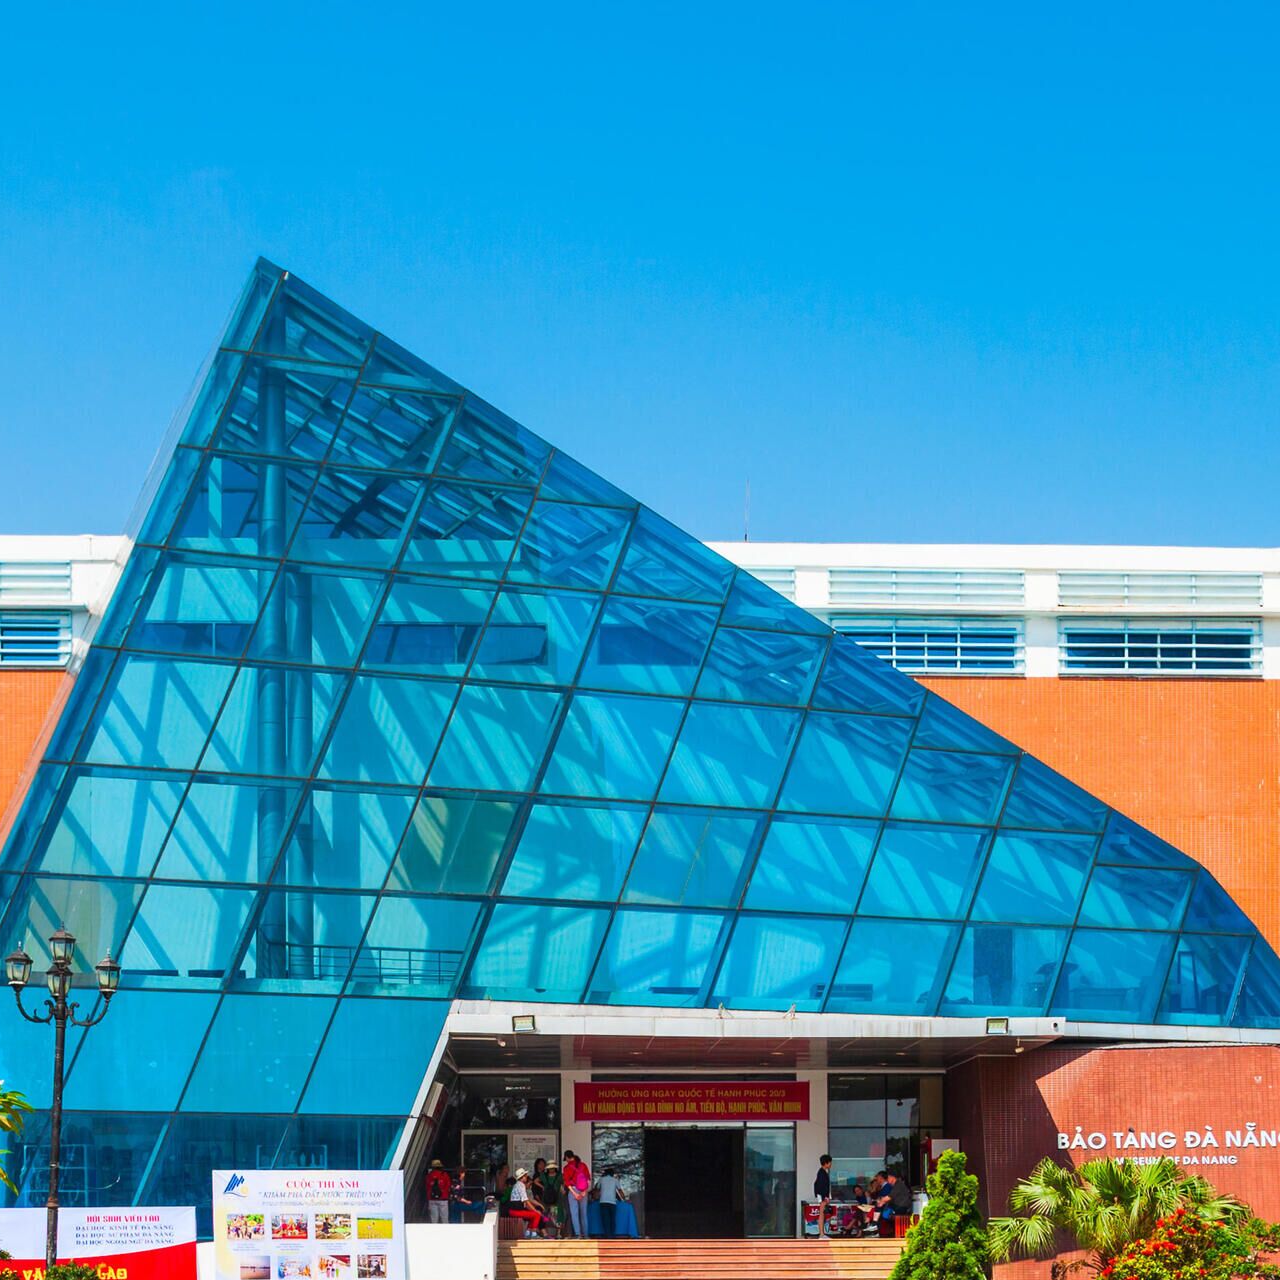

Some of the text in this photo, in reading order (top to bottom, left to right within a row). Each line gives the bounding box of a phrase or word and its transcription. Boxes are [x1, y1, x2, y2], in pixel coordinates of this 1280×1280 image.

[1057, 1126, 1107, 1150] BẢO
[1112, 1127, 1177, 1150] TÀNG
[1183, 1125, 1219, 1149] ĐÀ
[1115, 1156, 1162, 1166] MSEUM
[1182, 1156, 1199, 1165] DA
[1202, 1155, 1238, 1165] NANG
[318, 1179, 335, 1189] THI
